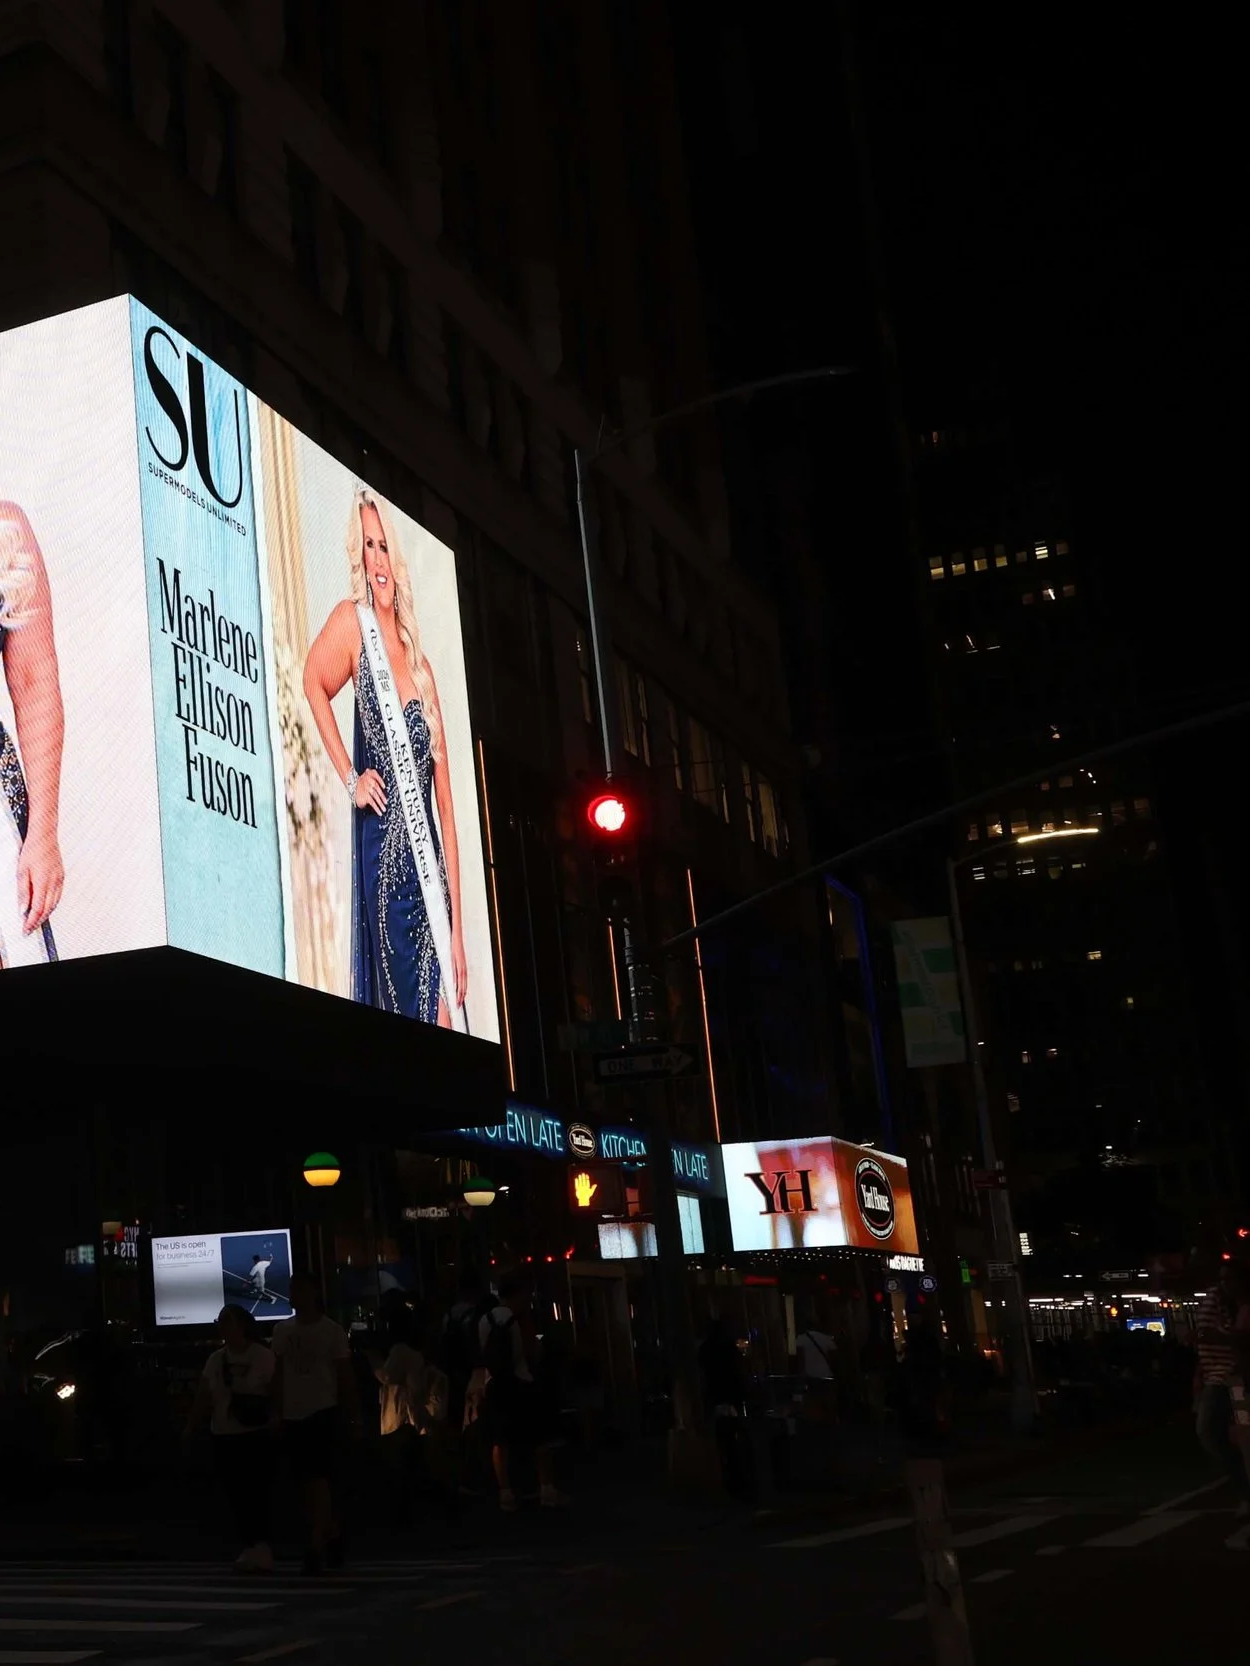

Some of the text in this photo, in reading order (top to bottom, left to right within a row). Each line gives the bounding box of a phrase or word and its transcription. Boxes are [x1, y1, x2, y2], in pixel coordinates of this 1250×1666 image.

[144, 325, 244, 509] SU
[148, 462, 247, 537] SUPERMODELS UNLIMITED
[156, 557, 258, 684] Marlene
[171, 642, 257, 755] Ellison
[182, 723, 258, 829] Fuson
[530, 1116, 564, 1152] LATE
[684, 1151, 709, 1180] LATE
[744, 1168, 819, 1216] YH
[156, 1243, 169, 1251] The
[170, 1241, 180, 1249] US
[188, 1240, 207, 1250] open
